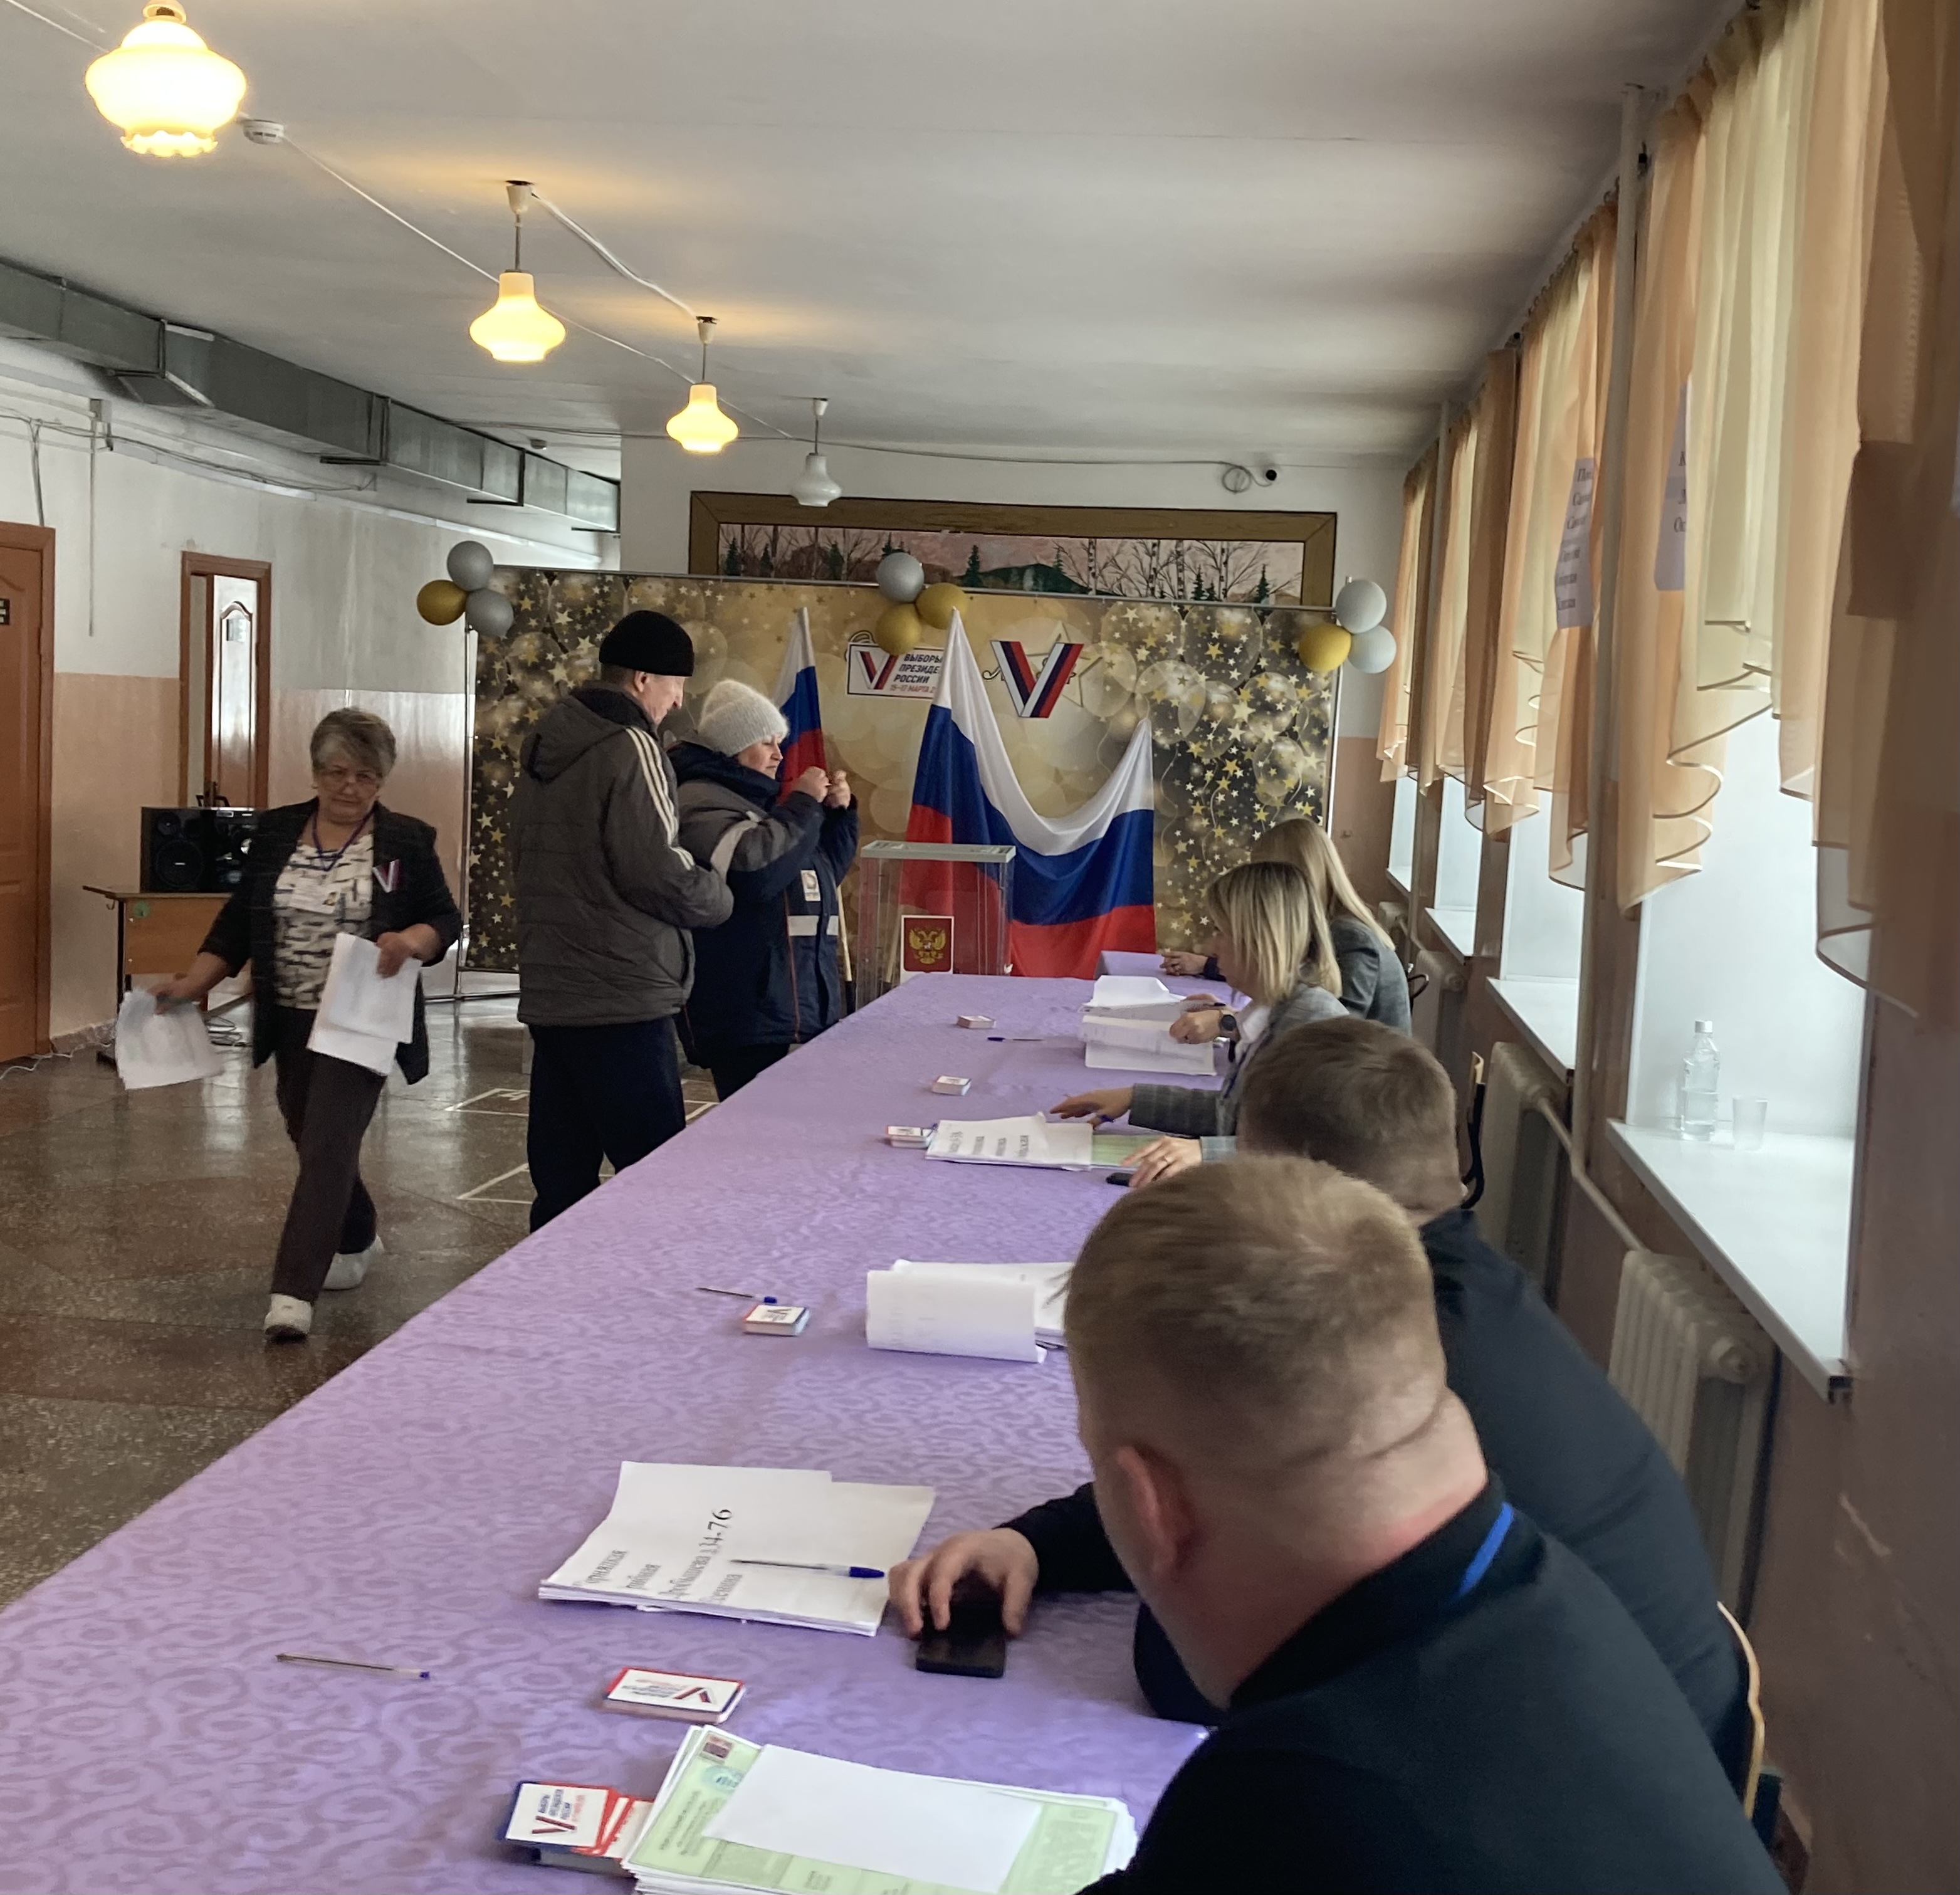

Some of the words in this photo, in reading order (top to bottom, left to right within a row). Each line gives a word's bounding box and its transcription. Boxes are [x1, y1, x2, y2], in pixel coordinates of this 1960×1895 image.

[904, 653, 943, 663] ВЫБОРЫ
[899, 663, 940, 674] ПРЕЗИДЕ
[893, 674, 930, 683] РОССИИ
